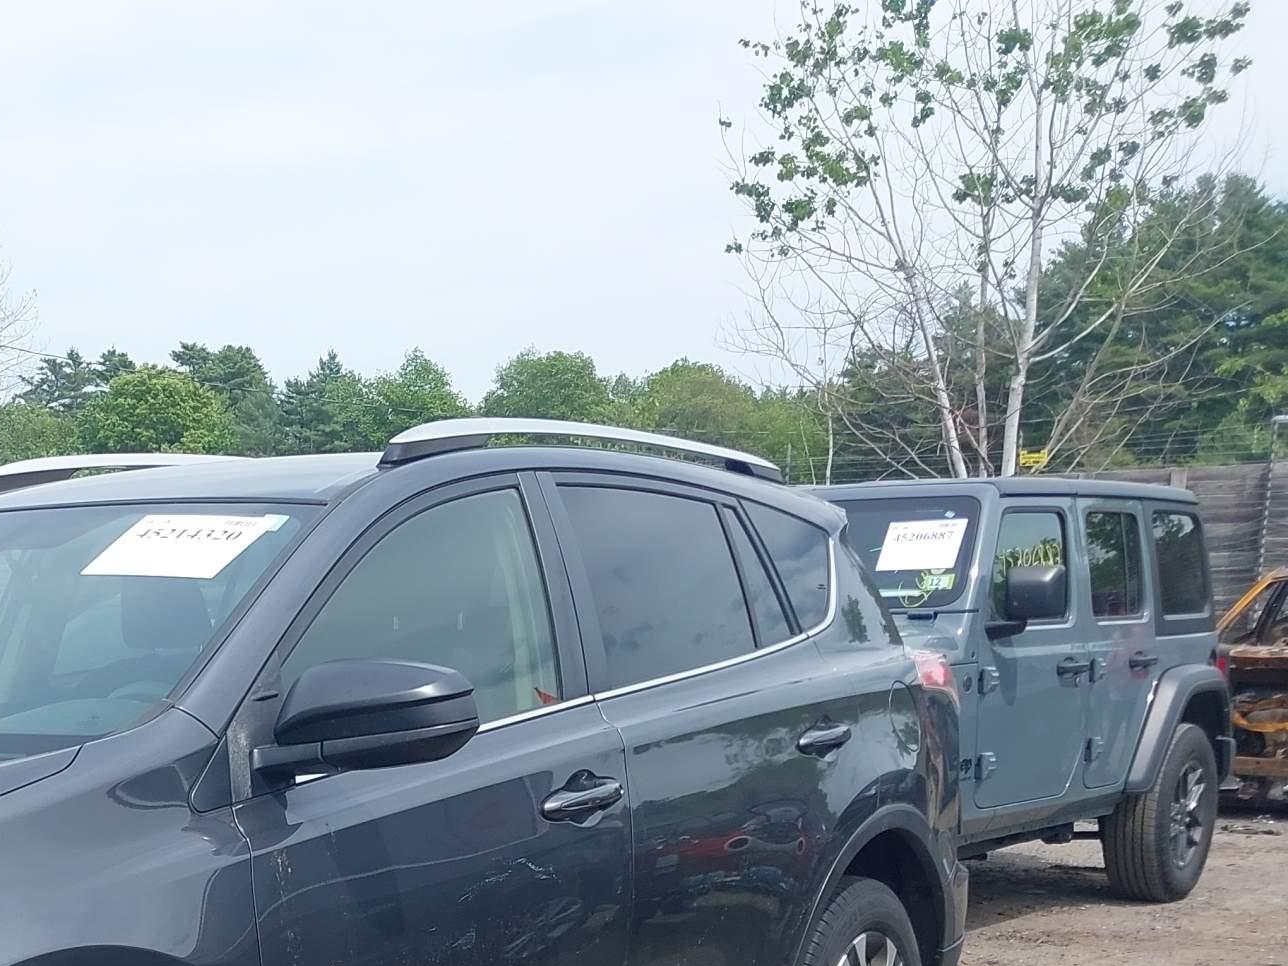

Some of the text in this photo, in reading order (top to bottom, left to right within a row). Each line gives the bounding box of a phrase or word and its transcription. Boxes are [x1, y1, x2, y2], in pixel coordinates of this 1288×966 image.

[136, 528, 243, 541] 45214320
[891, 530, 954, 544] 45206887
[930, 577, 942, 587] 12
